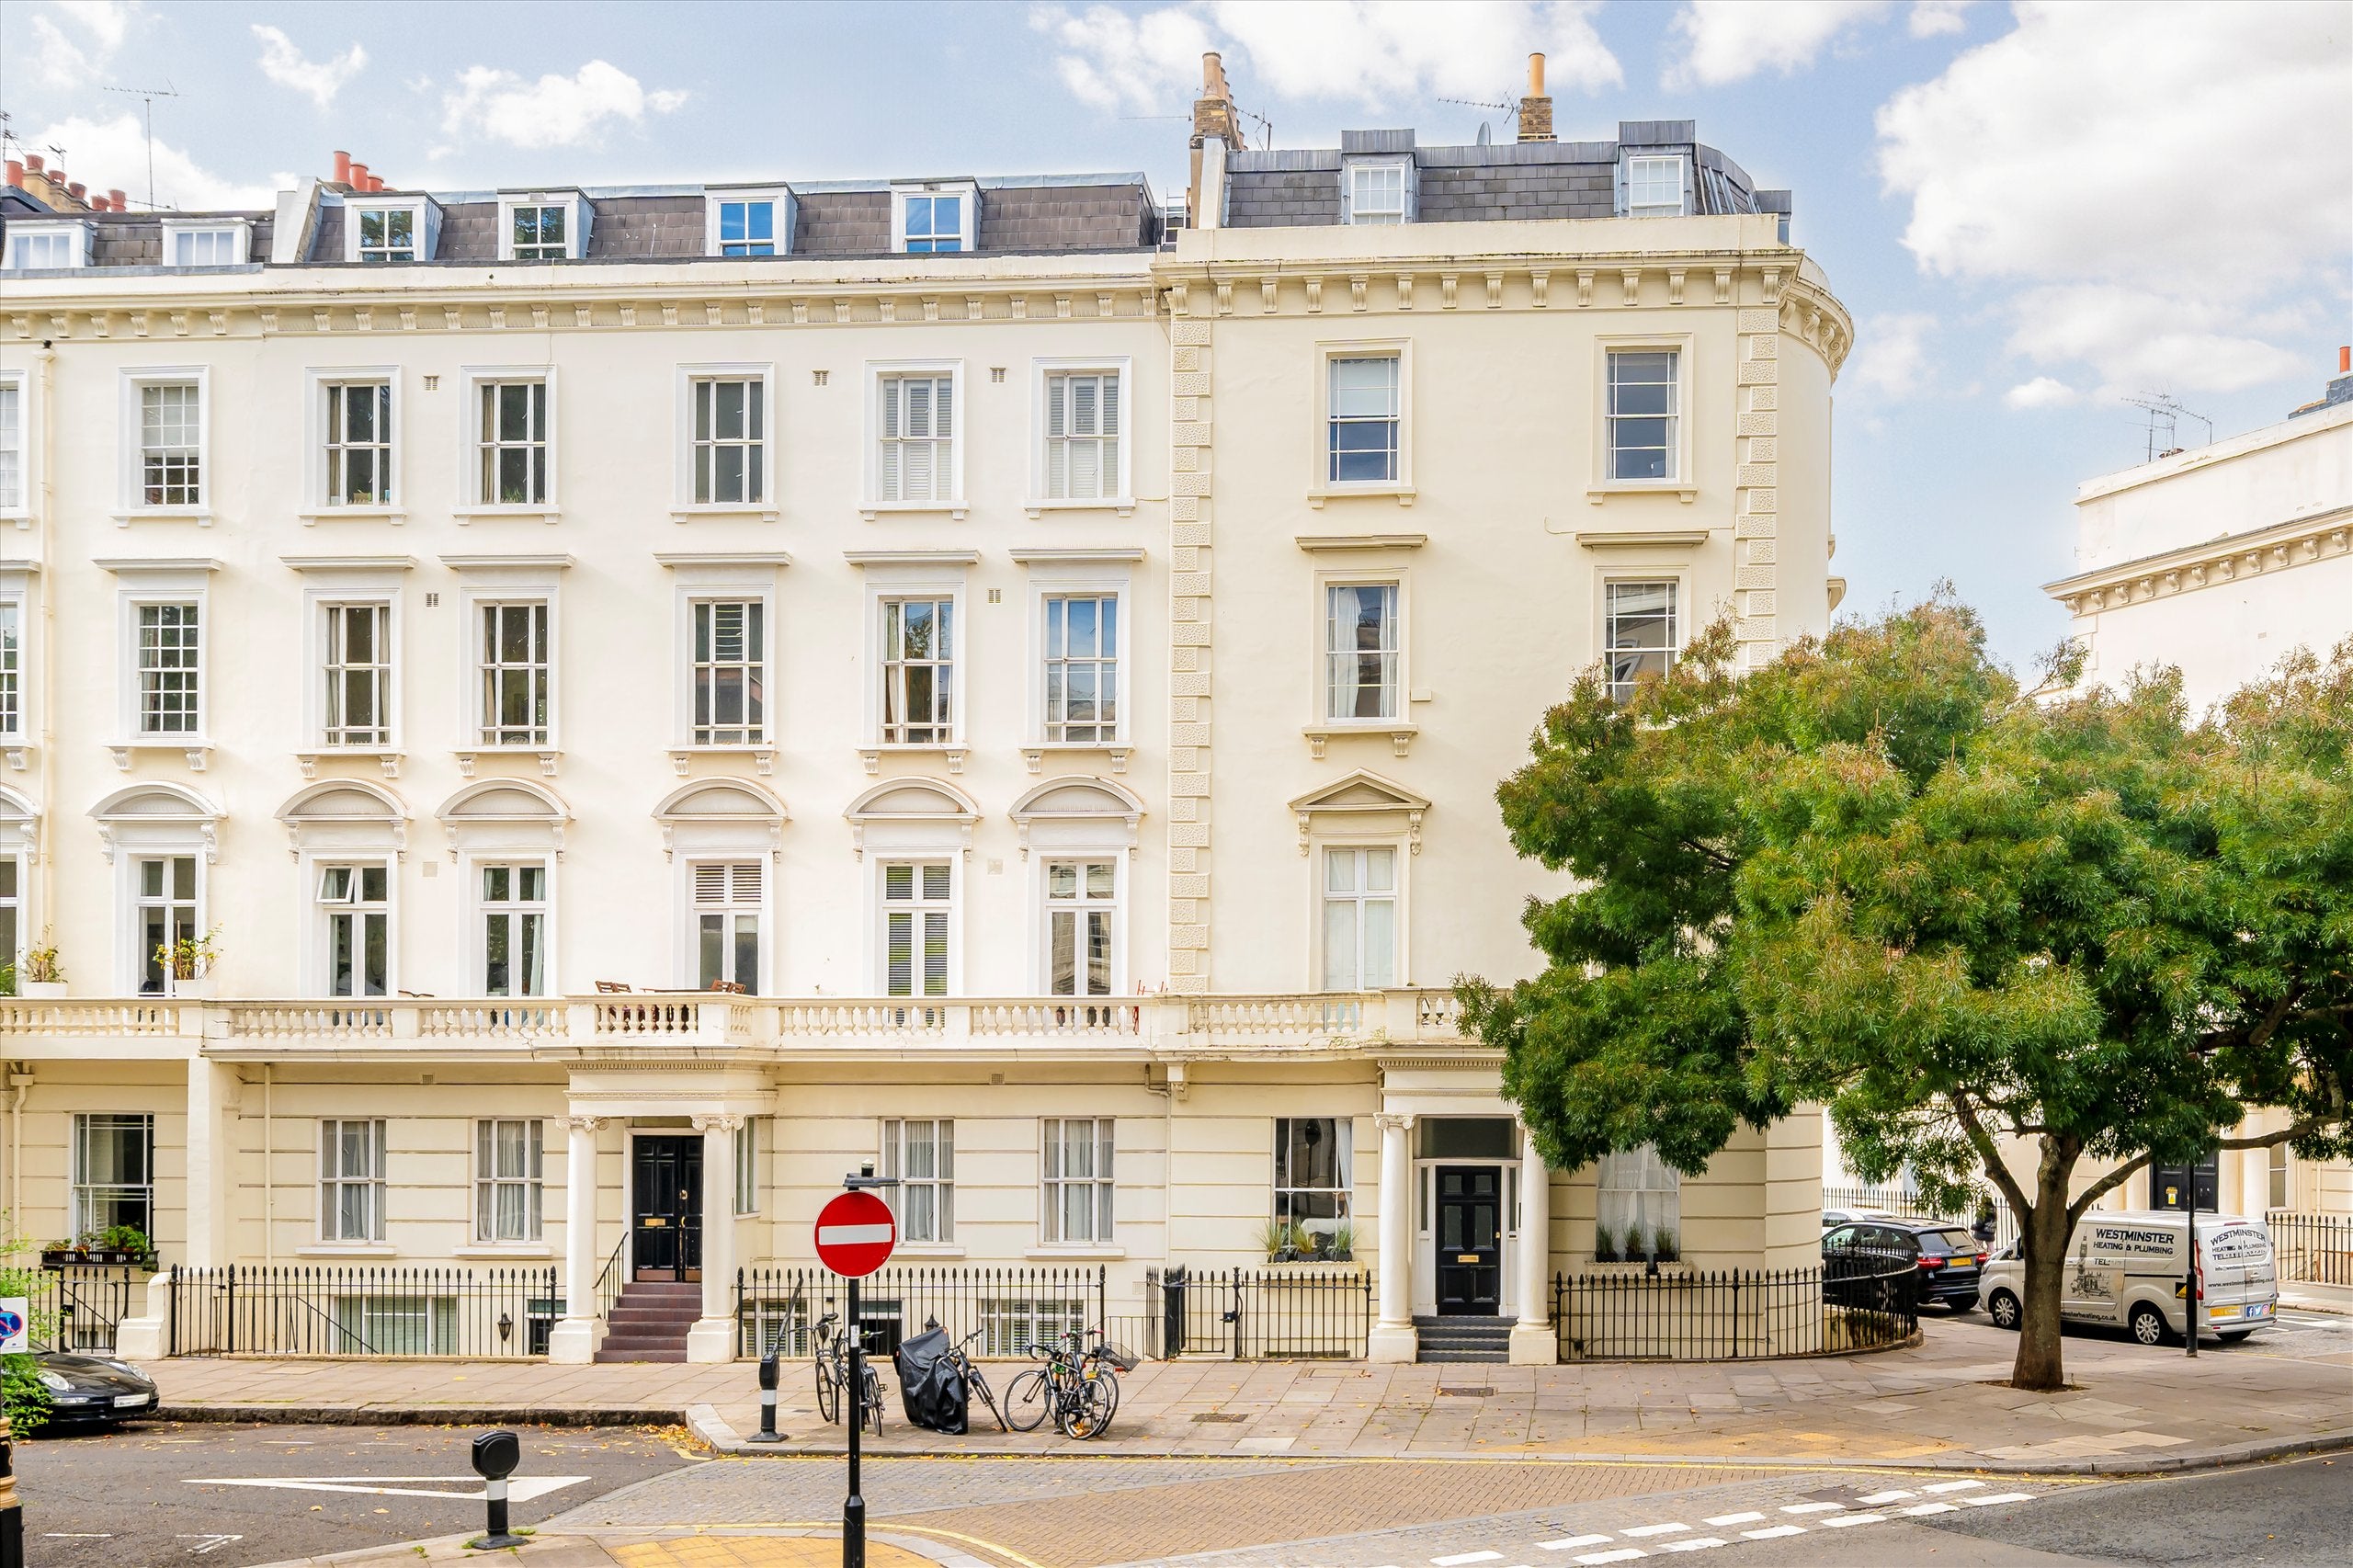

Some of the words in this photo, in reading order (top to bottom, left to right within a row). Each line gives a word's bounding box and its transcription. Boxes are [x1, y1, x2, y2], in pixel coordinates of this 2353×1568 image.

[2096, 1228, 2175, 1244] WESTMINSTER
[2210, 1229, 2267, 1246] WESTMINSTER
[2093, 1241, 2123, 1251] HEATING
[2125, 1244, 2132, 1252] &
[2133, 1244, 2174, 1256] PLUMBING
